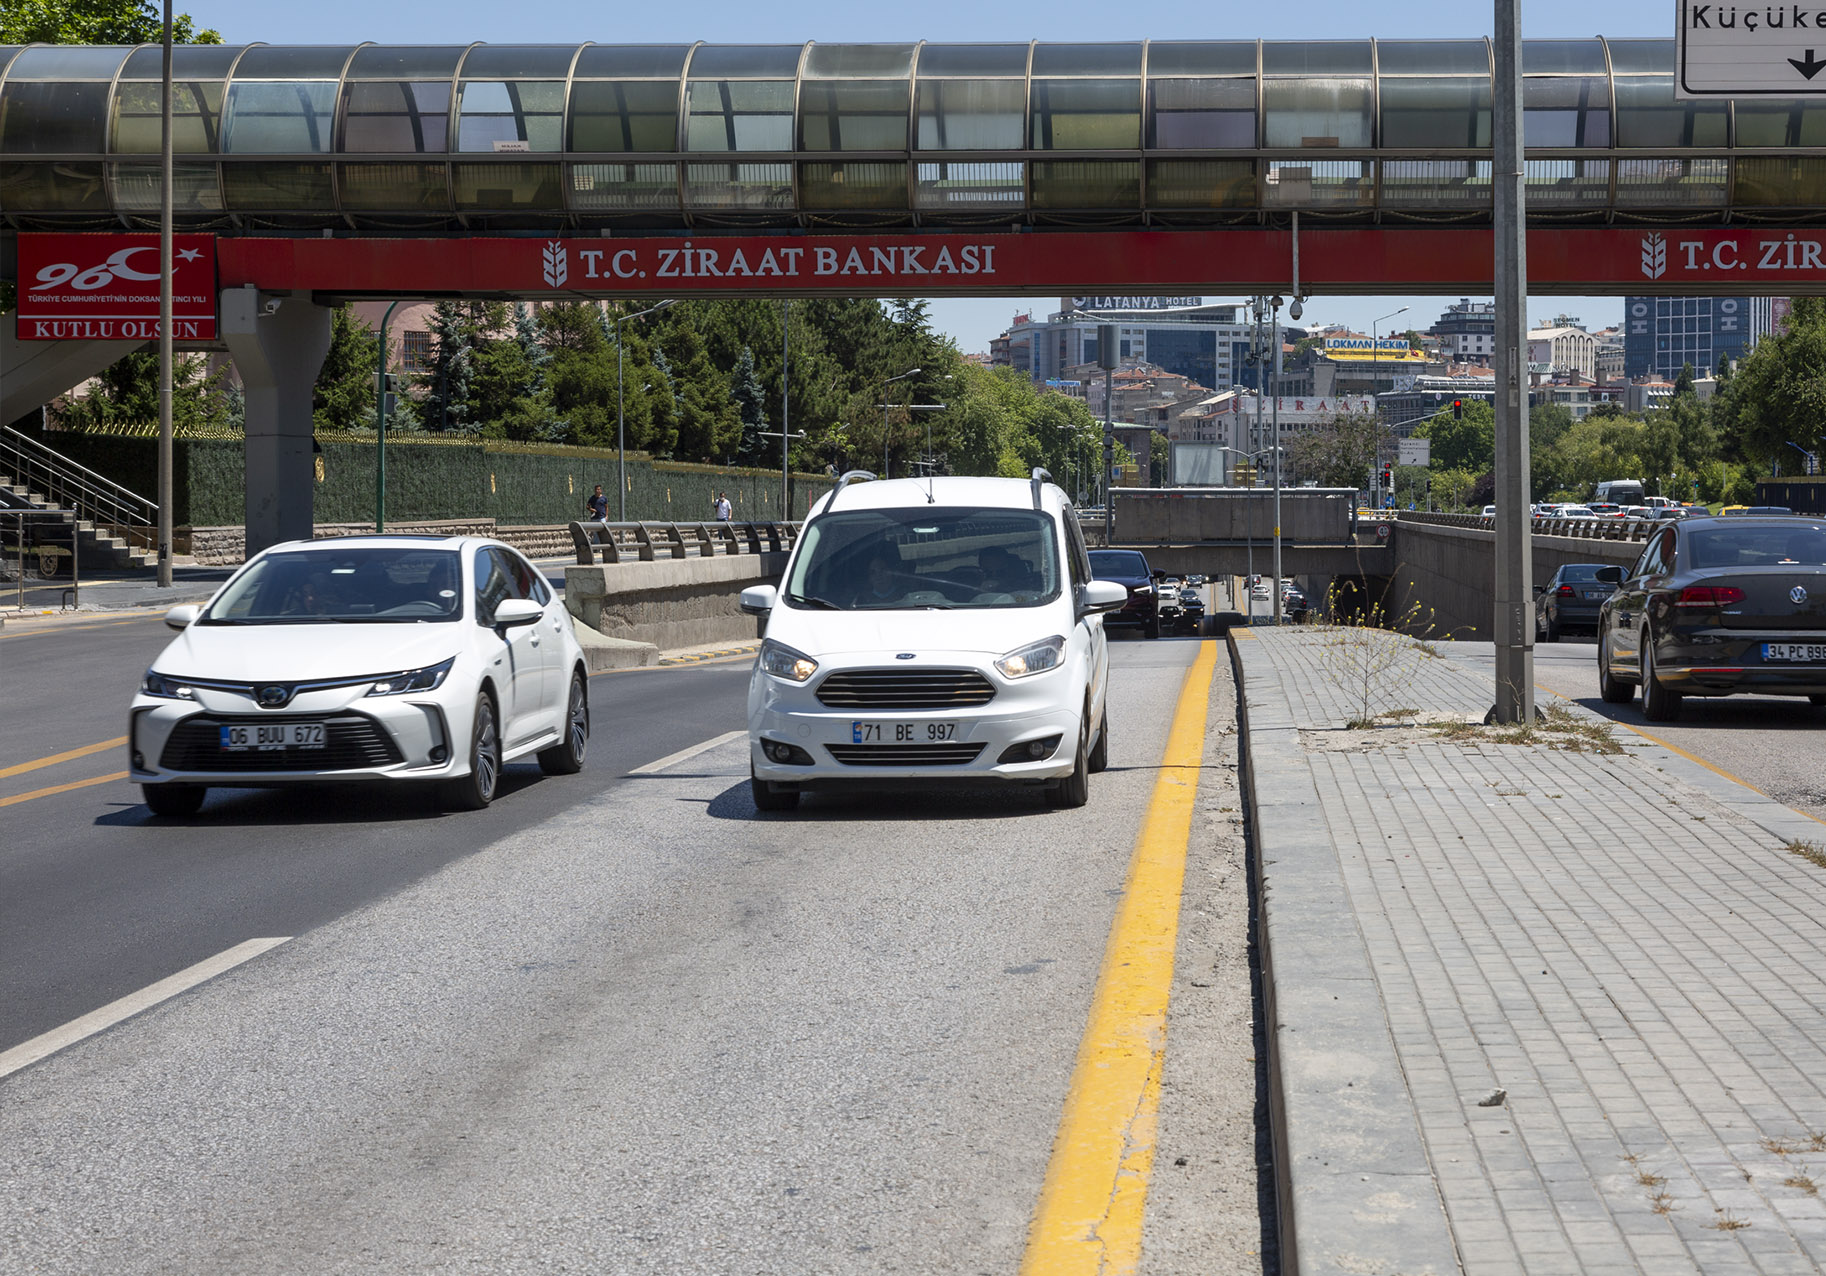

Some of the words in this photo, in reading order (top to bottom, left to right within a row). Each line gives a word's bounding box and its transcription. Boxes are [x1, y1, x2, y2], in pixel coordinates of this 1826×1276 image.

[1679, 240, 1747, 270] T.C.
[1757, 233, 1826, 269] ZİR
[580, 249, 646, 279] T.C.
[657, 241, 804, 277] ZİRAAT
[813, 244, 997, 275] BANKASI
[28, 294, 60, 303] TÜRKİYE
[192, 295, 207, 303] YILI
[1094, 296, 1160, 309] LATANYA
[1165, 296, 1199, 306] HOTEL
[34, 321, 114, 337] KUTLU
[1327, 339, 1372, 349] LOKMAN
[1769, 645, 1784, 658] 34
[1789, 645, 1804, 658] PC
[230, 728, 248, 744] 06
[294, 726, 322, 742] 672
[864, 724, 881, 741] 71
[896, 724, 914, 741] BE
[927, 724, 955, 741] 997
